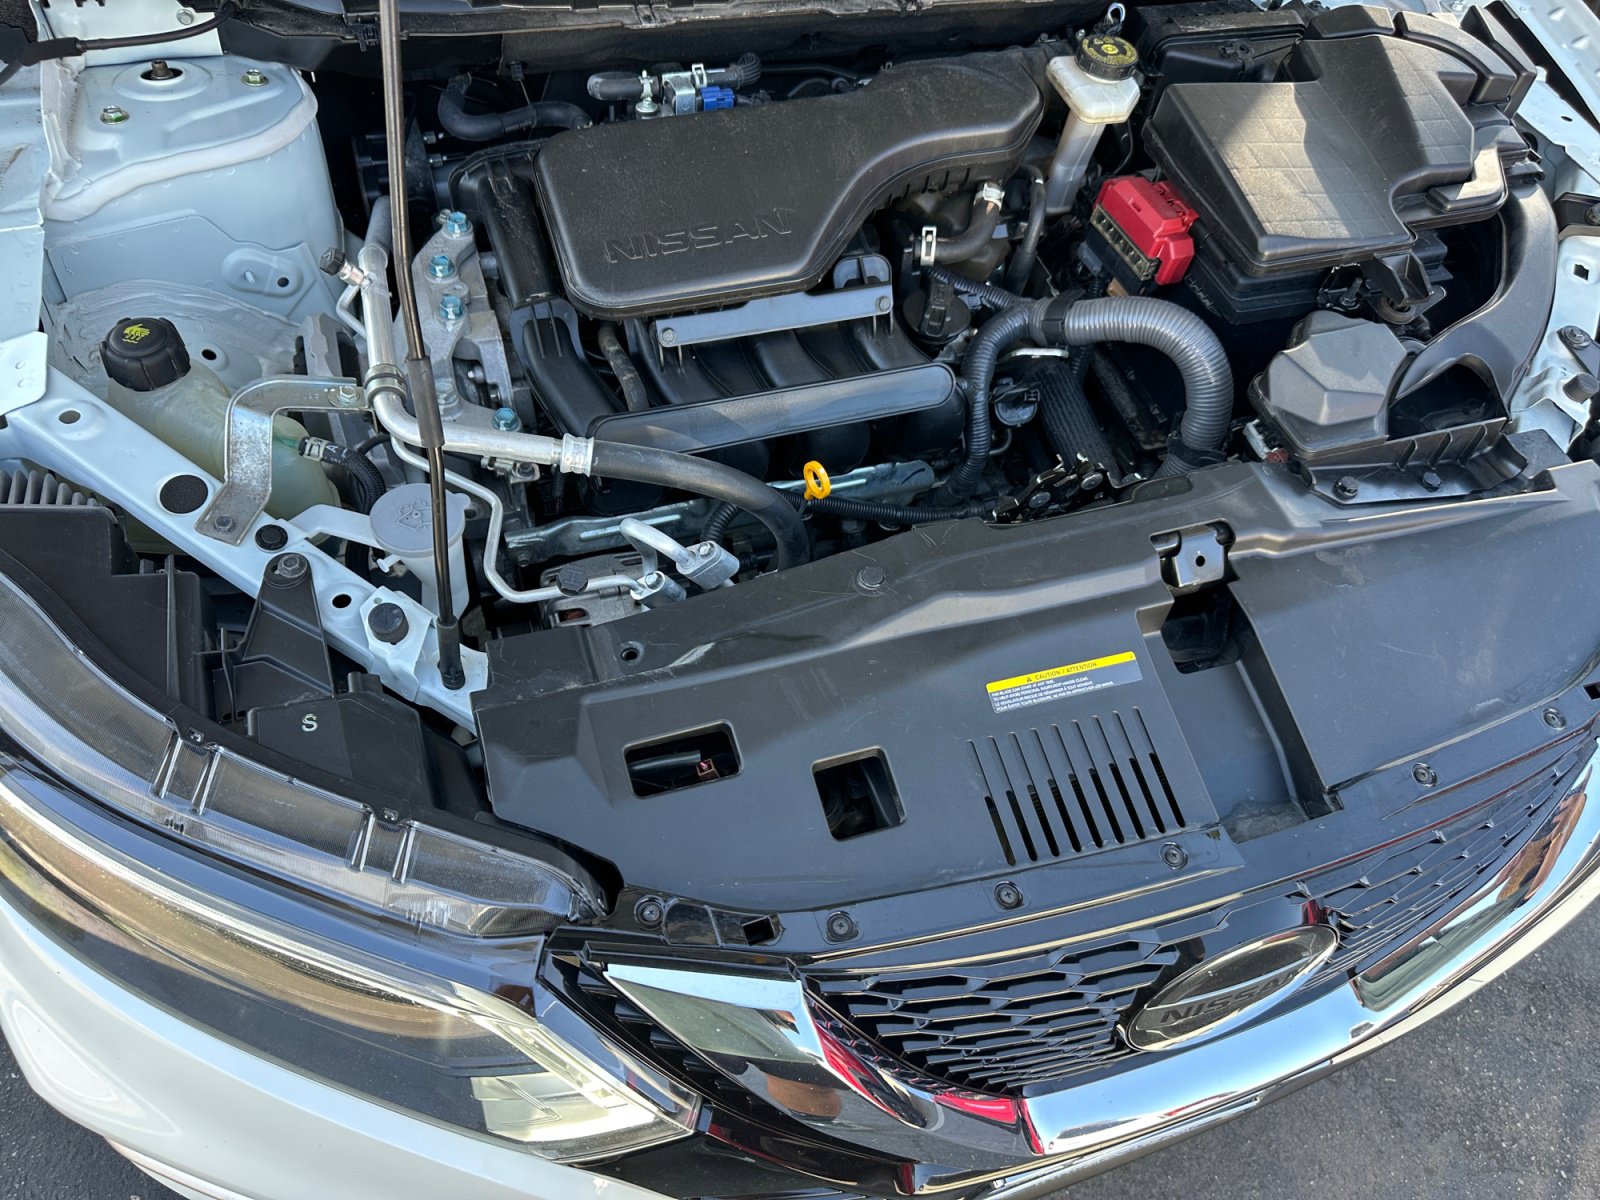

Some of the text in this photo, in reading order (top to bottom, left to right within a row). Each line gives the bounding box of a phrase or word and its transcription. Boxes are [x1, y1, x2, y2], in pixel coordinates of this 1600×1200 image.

[603, 208, 793, 263] NISSAN
[1034, 669, 1060, 680] CAUTION
[1066, 662, 1097, 673] ATTENTION
[302, 713, 318, 732] S
